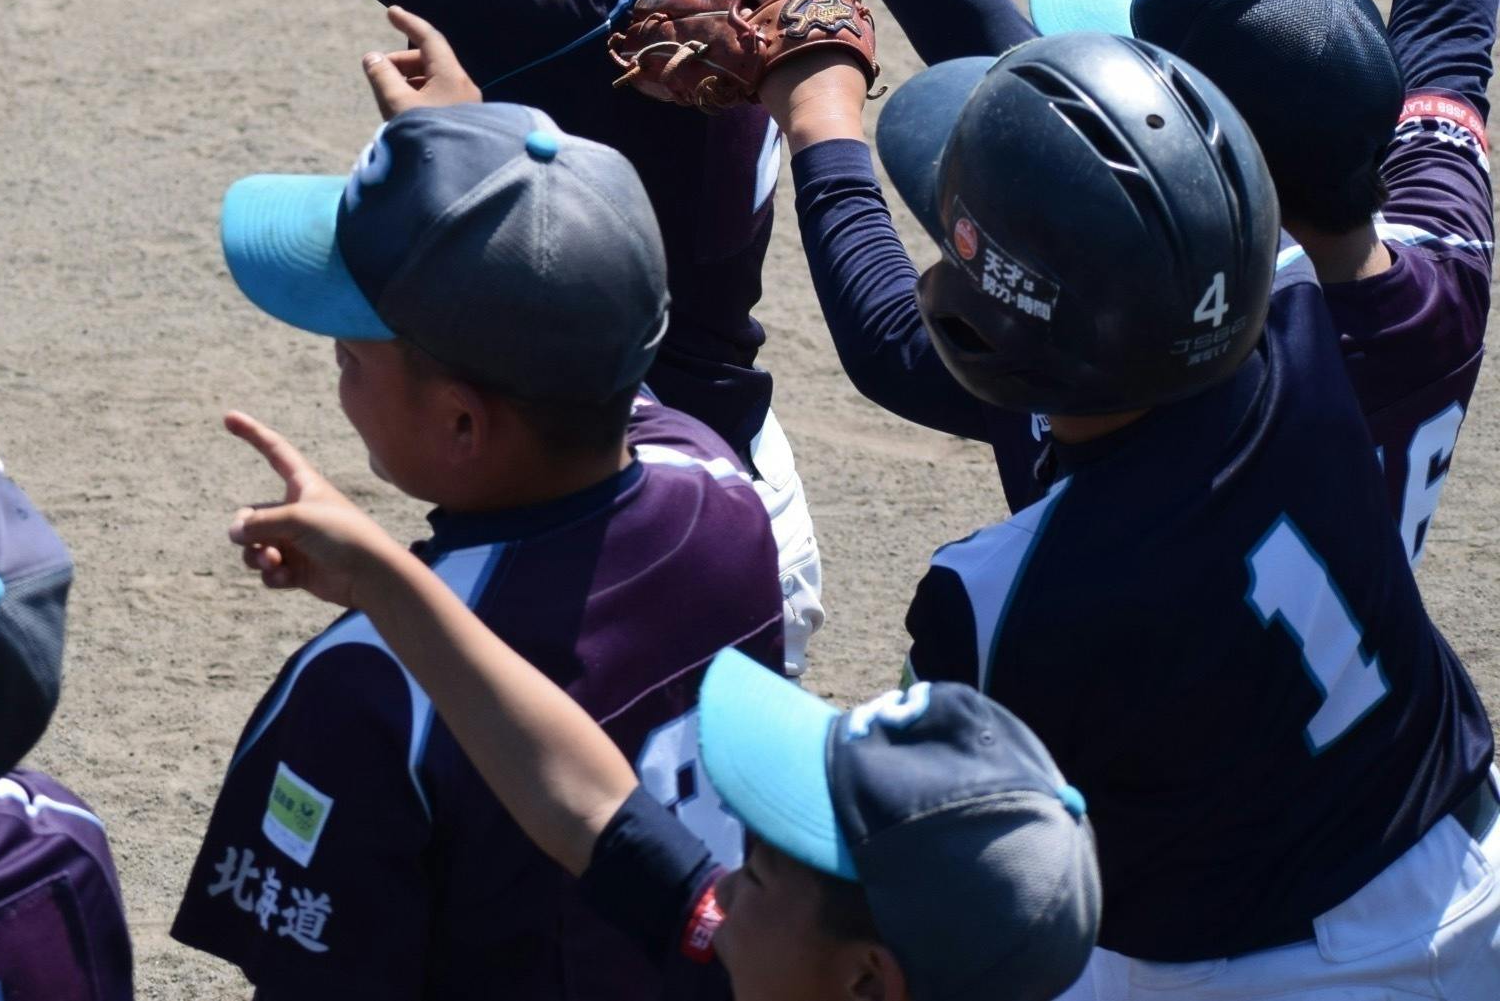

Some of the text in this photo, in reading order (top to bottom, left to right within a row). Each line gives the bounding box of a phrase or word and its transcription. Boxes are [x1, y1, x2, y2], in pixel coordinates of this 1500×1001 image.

[1193, 271, 1229, 328] 4
[1243, 511, 1392, 757] 1
[208, 846, 333, 953] 北海道
